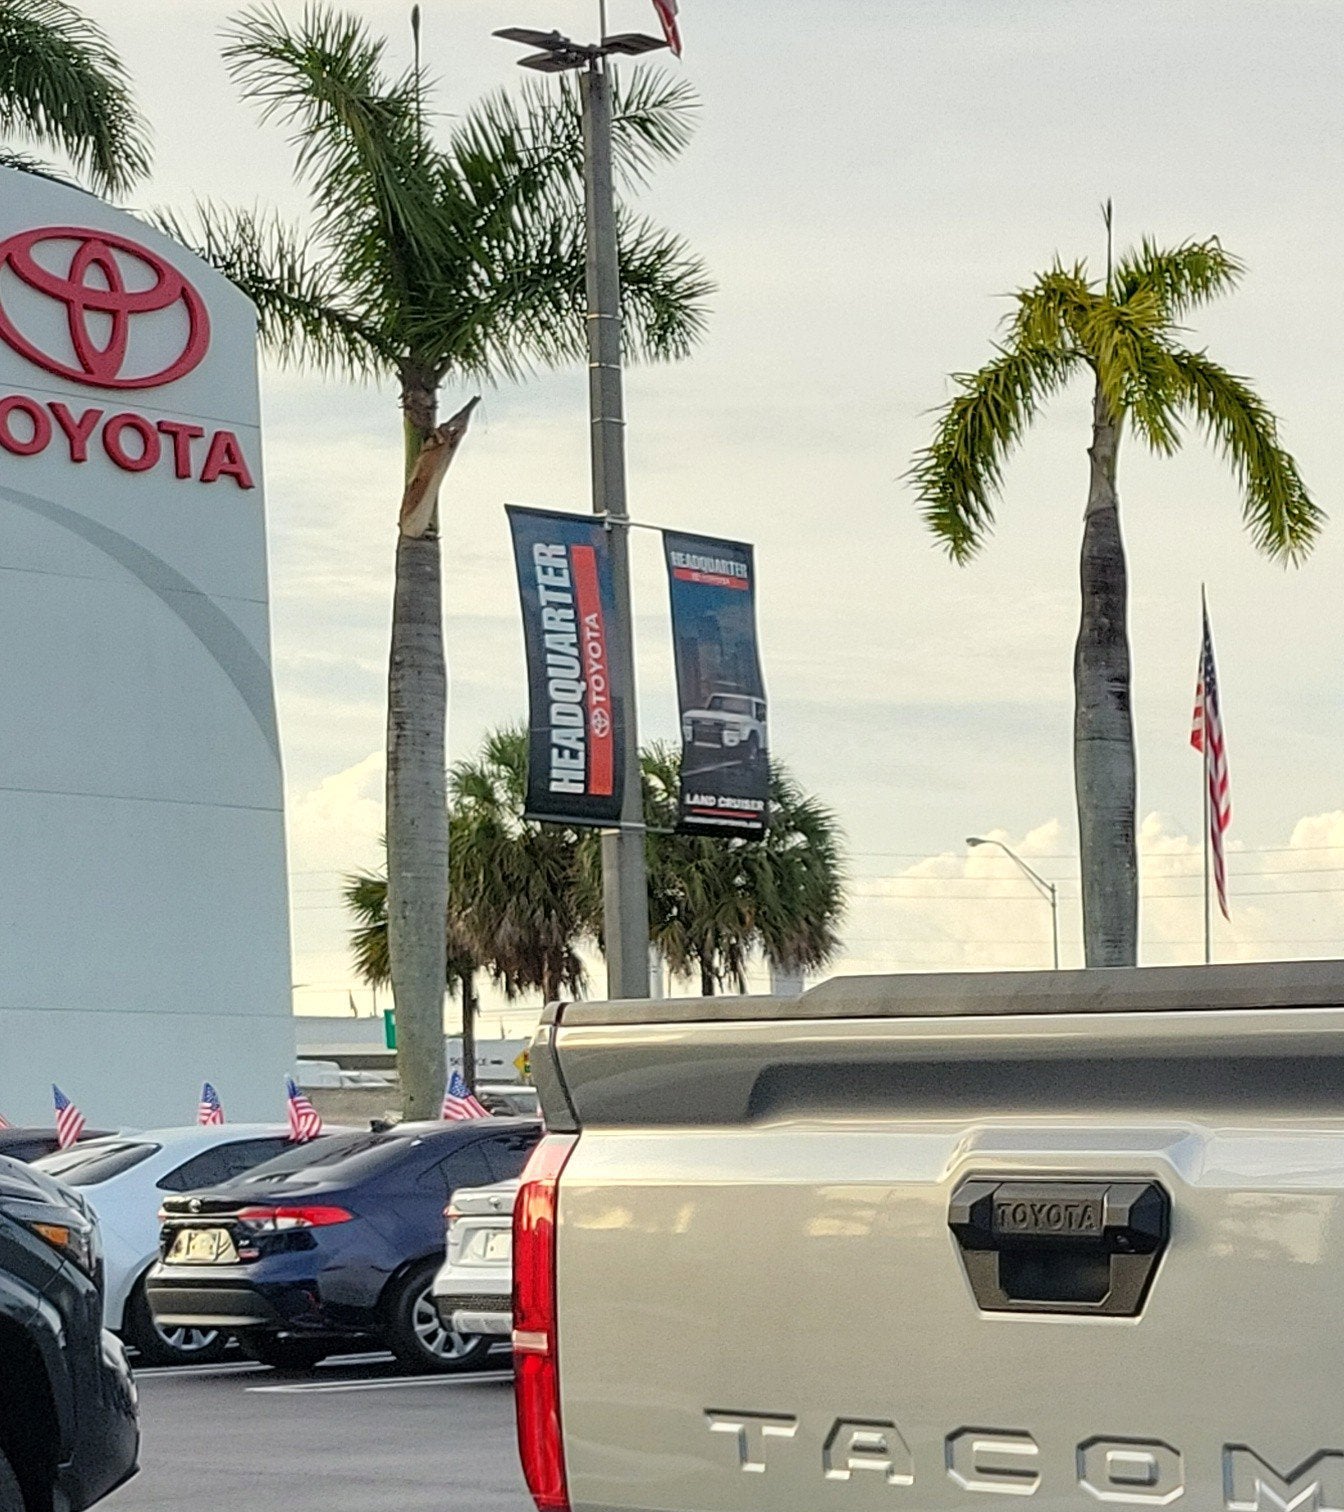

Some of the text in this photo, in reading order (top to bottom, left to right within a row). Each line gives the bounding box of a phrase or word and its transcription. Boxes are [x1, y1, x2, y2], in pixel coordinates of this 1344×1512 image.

[533, 541, 586, 795] HEADQUARTER
[585, 613, 605, 704] TOYOTA
[684, 793, 765, 811] LAND CRUISER
[998, 1202, 1098, 1231] TOYOTA
